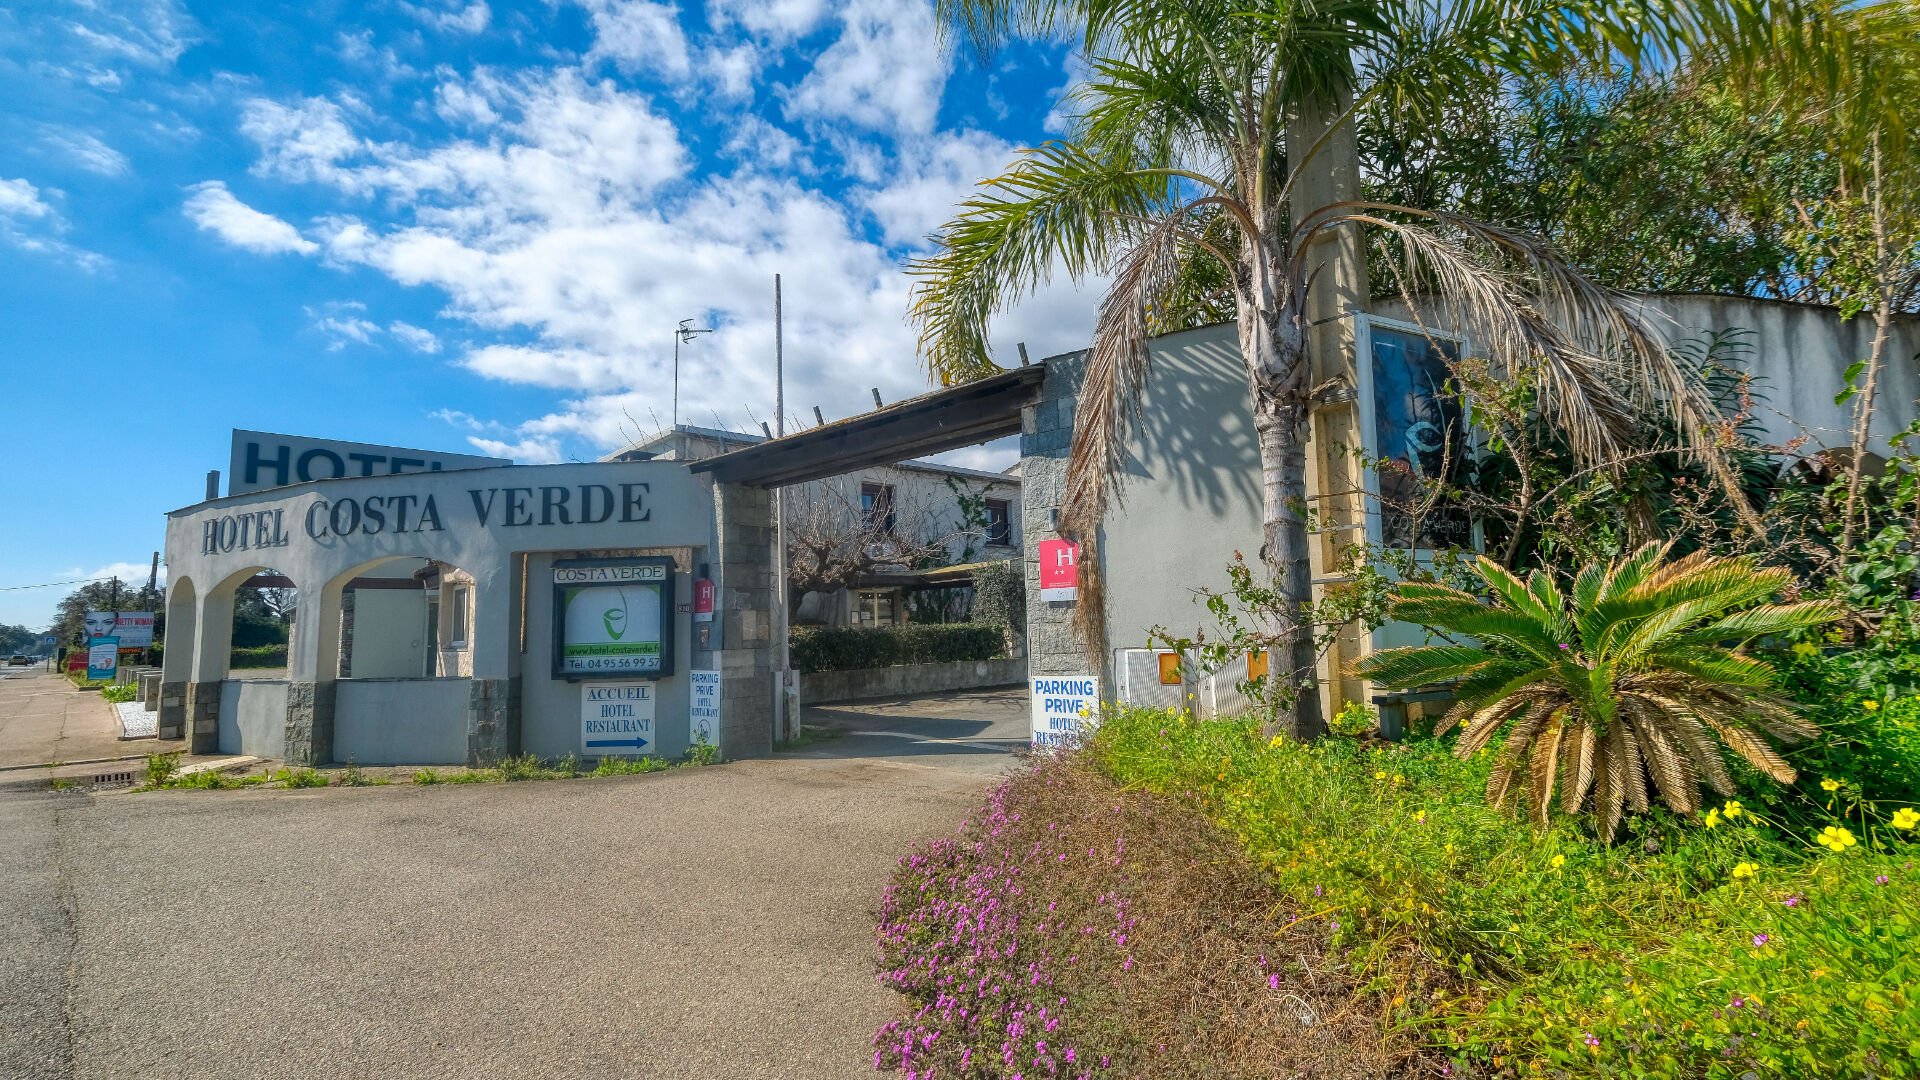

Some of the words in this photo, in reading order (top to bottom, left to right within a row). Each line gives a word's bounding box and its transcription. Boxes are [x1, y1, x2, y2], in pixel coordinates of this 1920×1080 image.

[244, 442, 442, 486] HOT
[200, 508, 289, 556] HOTEL
[304, 493, 446, 539] COSTA
[467, 482, 650, 529] VERDE
[1056, 547, 1073, 567] H
[556, 568, 608, 581] COSTA
[611, 566, 663, 579] VERDE
[702, 586, 711, 599] H
[569, 659, 585, 669] Tél.
[588, 659, 601, 669] 04
[604, 659, 616, 668] 95
[618, 658, 631, 668] 56
[633, 658, 645, 667] 99
[648, 657, 660, 667] 57
[691, 673, 719, 684] PARKING
[587, 688, 650, 700] ACCUEIL
[695, 685, 714, 696] PRIVE
[1035, 680, 1093, 696] PARKING
[600, 704, 636, 718] HOTEL
[1045, 698, 1083, 713] PRIVE
[586, 719, 651, 733] RESTAURANT
